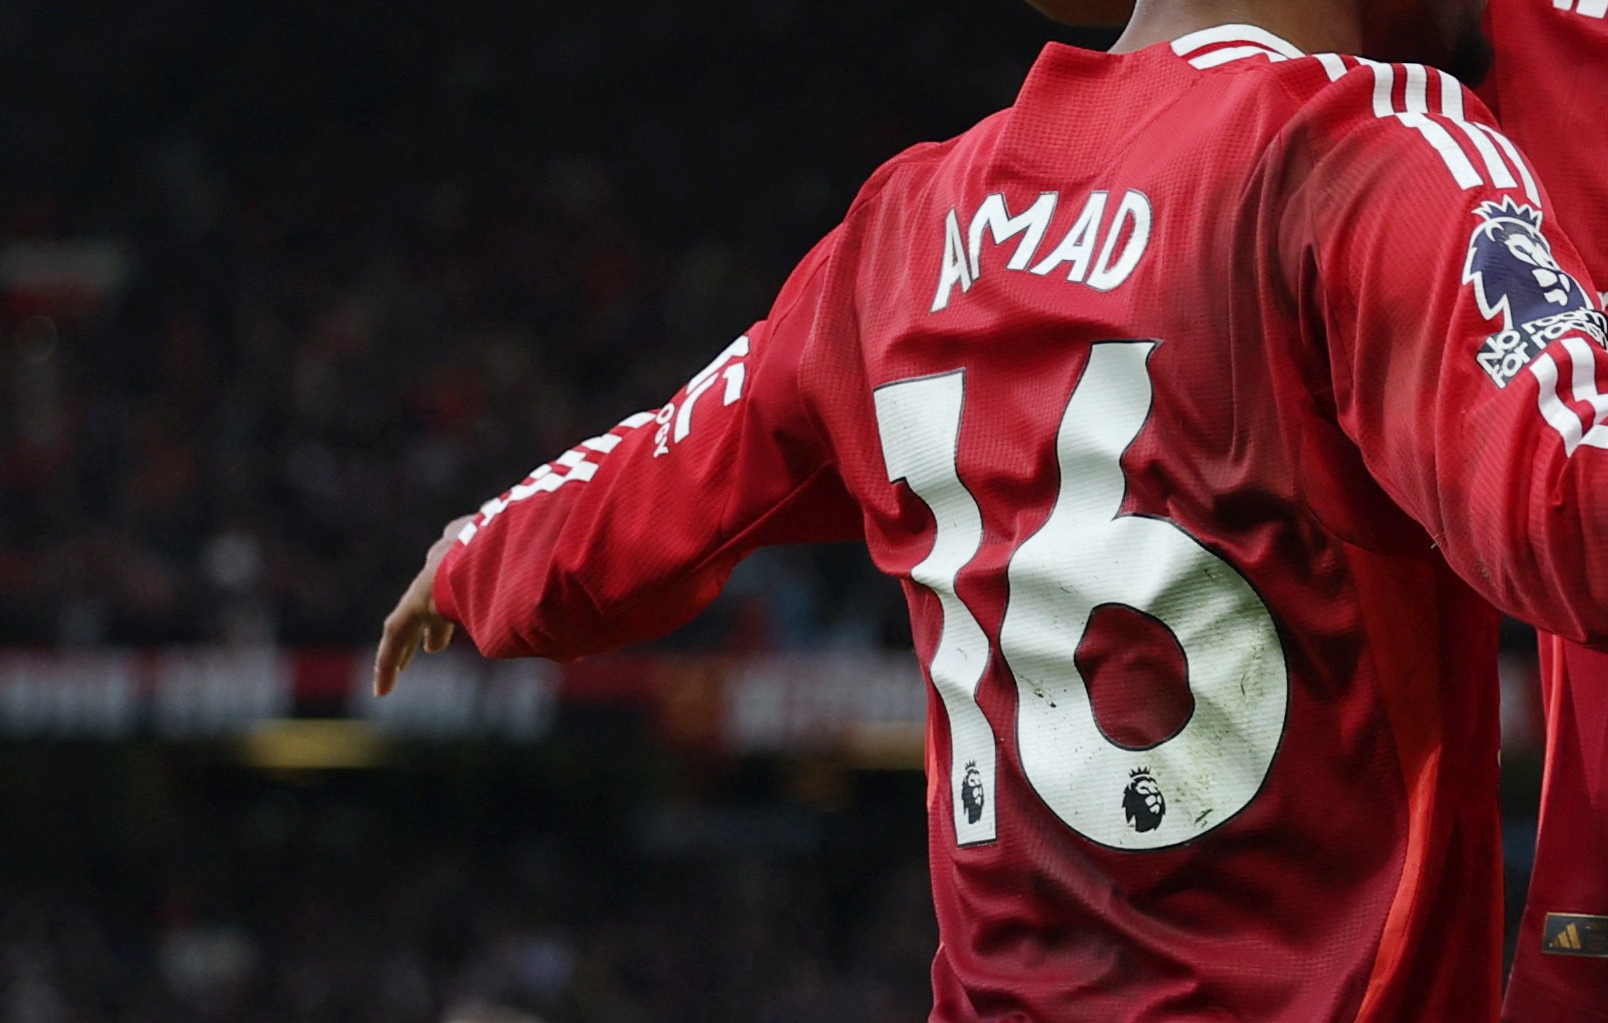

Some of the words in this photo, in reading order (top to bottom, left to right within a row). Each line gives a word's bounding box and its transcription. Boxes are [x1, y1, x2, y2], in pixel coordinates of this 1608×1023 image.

[930, 188, 1154, 313] AMAD
[1476, 328, 1521, 376] No
[872, 338, 1290, 851] 16
